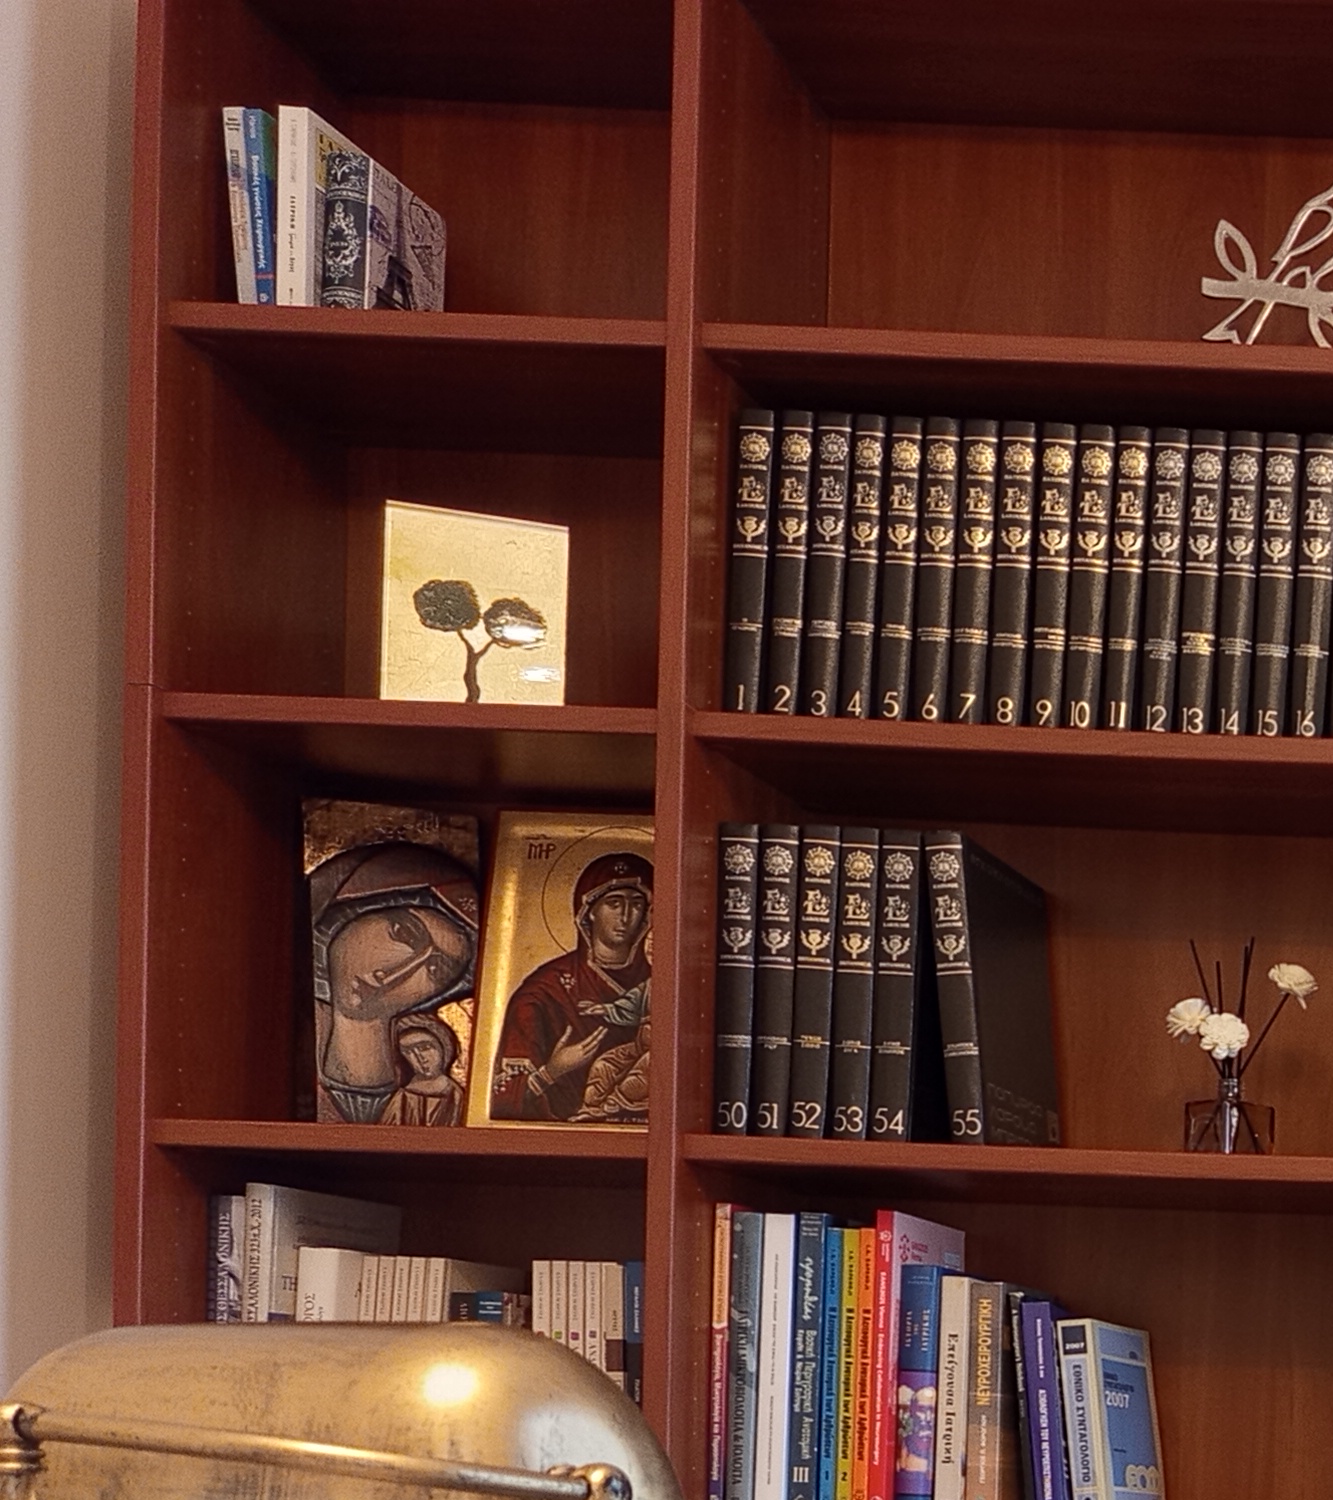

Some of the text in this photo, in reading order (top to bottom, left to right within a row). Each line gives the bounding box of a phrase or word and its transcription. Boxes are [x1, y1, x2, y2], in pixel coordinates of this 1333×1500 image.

[737, 684, 745, 711] 1
[773, 685, 790, 712] 2
[811, 690, 827, 716] 3
[847, 690, 861, 716] 4
[882, 691, 899, 718] 5
[921, 693, 938, 720] 6
[959, 693, 976, 719] 7
[996, 696, 1014, 724] 8
[1035, 699, 1052, 726] 9
[1070, 700, 1090, 728] 10
[1110, 700, 1127, 728] 11
[1146, 704, 1167, 732] 12
[1182, 707, 1204, 734] 13
[1220, 708, 1239, 735] 14
[1257, 709, 1278, 737] 15
[1296, 709, 1315, 737] 16
[718, 1101, 747, 1128] 50
[757, 1103, 778, 1129] 51
[791, 1102, 821, 1129] 52
[833, 1106, 863, 1133] 53
[873, 1107, 904, 1135] 54
[953, 1109, 981, 1136] 55
[975, 1298, 993, 1407] ΝΕΥΡΟΧΕΙΡΟΥΡΓΙΚΗ
[1064, 1341, 1087, 1351] 2007
[940, 1332, 960, 1464] Επείγουσα Ιατρική
[1104, 1389, 1130, 1410] 2007
[1072, 1363, 1092, 1484] ΕΘΝΙΚΟ ΣΥΝΤΑΓΟΛΟΓΙΟ
